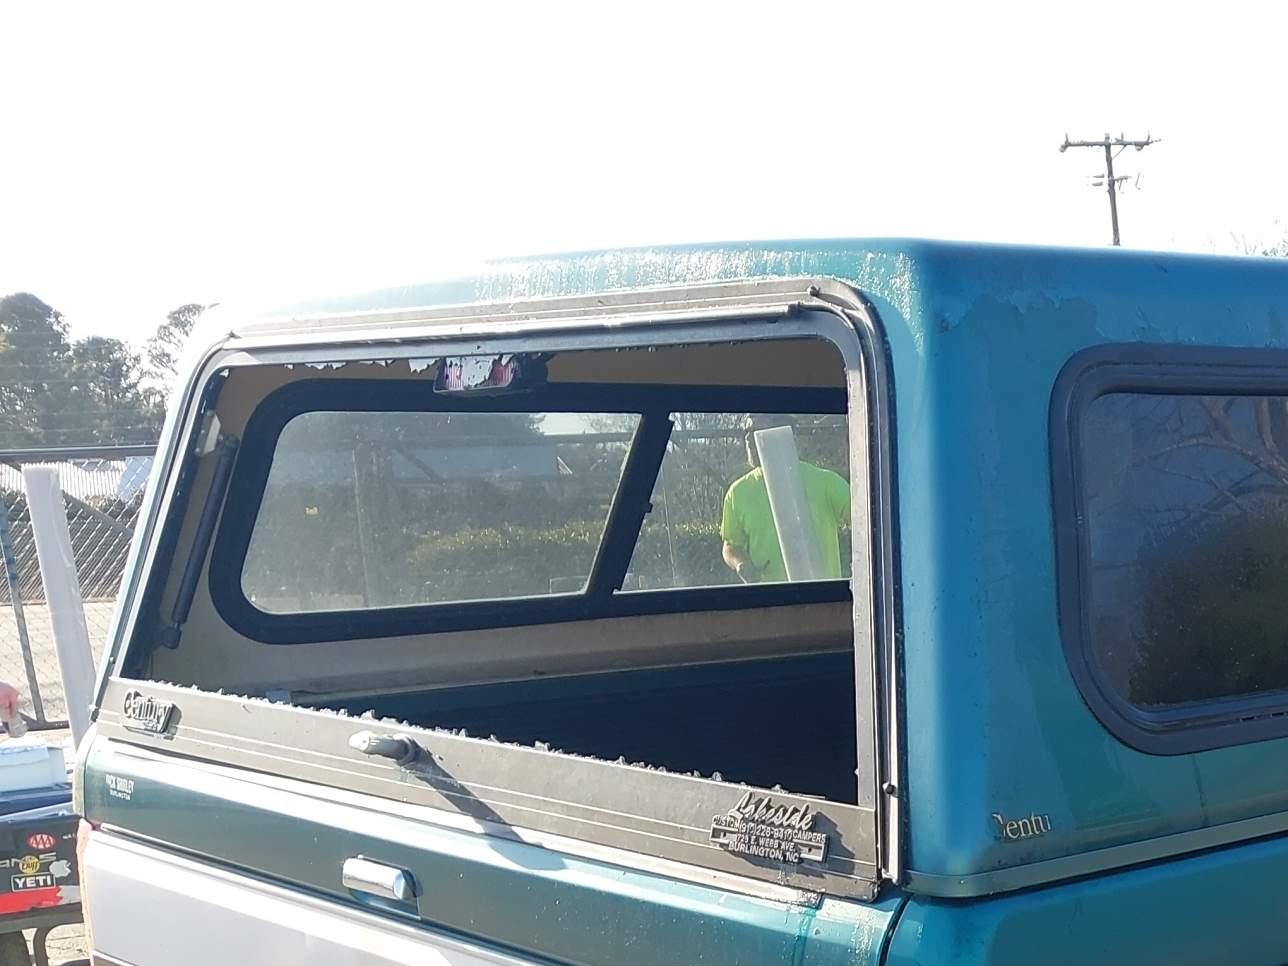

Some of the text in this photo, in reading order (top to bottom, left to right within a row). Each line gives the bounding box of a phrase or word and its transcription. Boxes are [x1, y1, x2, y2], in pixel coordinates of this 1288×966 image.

[124, 688, 172, 734] Century
[728, 791, 812, 831] Lakeside
[712, 814, 740, 829] CUSTOM
[793, 829, 826, 844] CAMPERS
[29, 834, 54, 849] AAA
[759, 837, 779, 848] WEBB
[728, 842, 800, 863] BURLINGTON, NC
[15, 875, 51, 889] YETI
